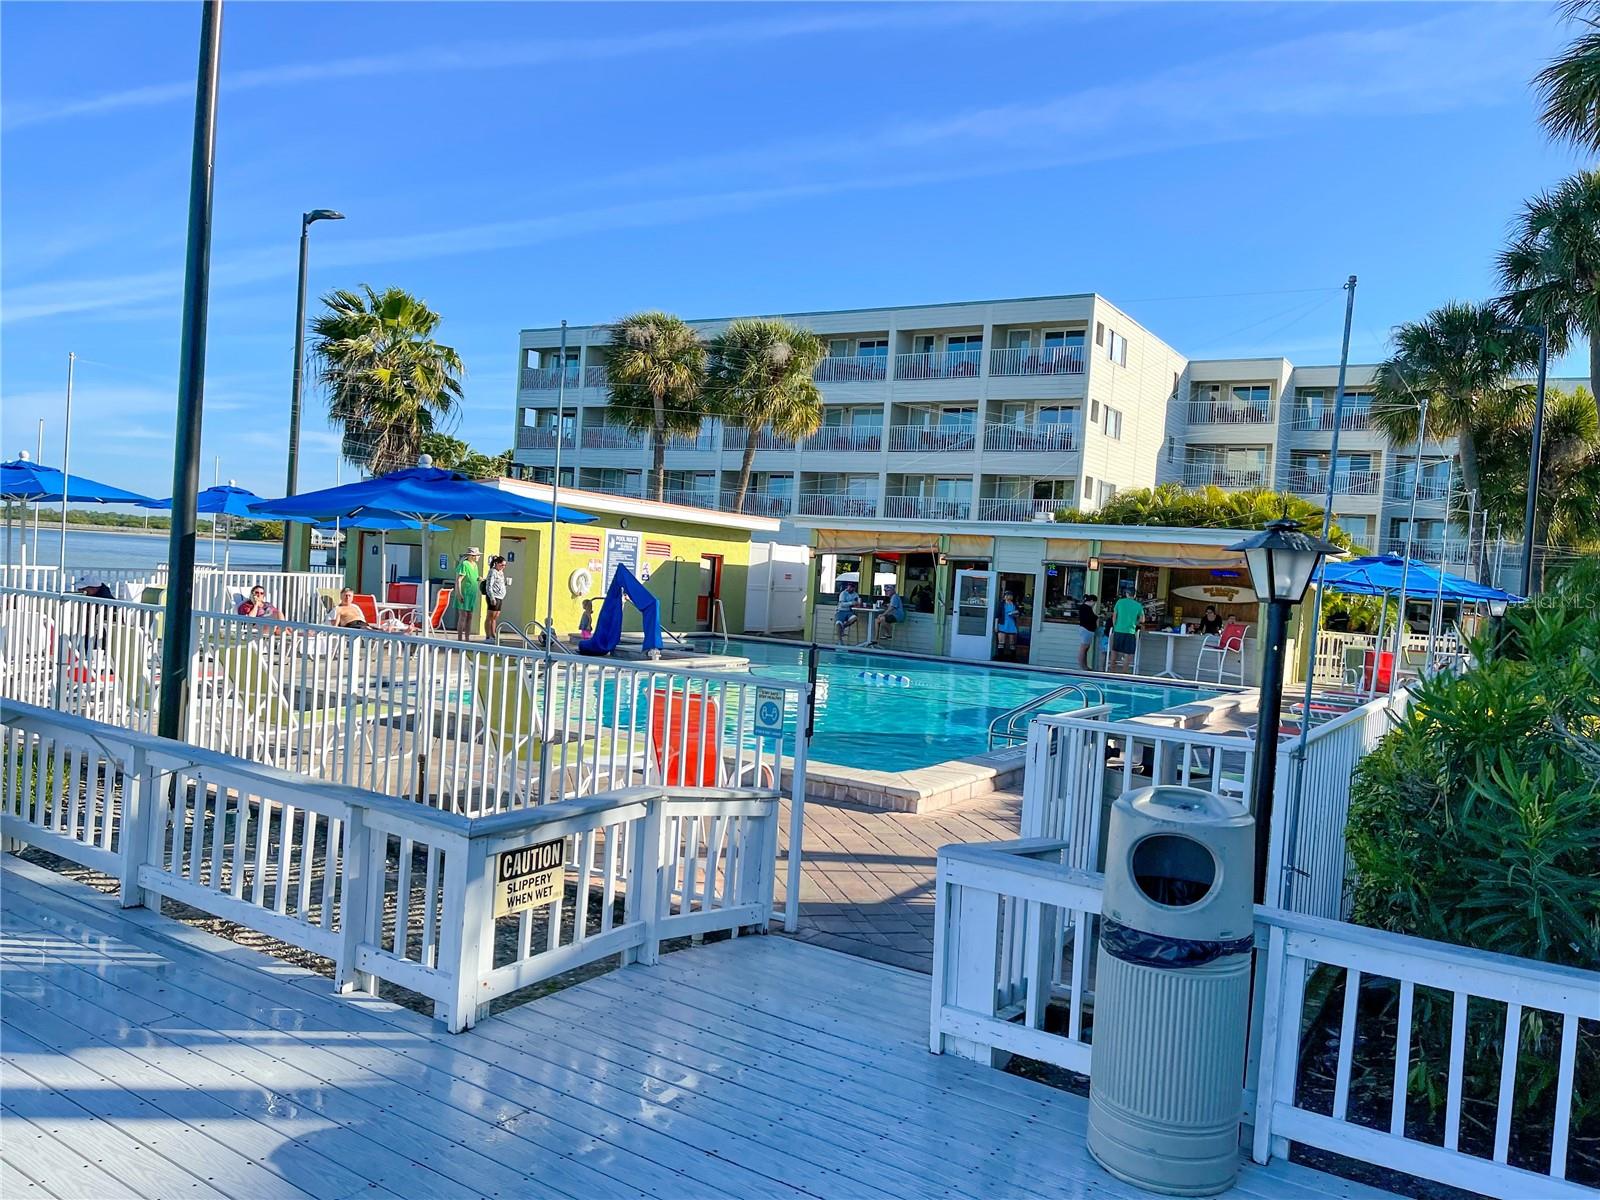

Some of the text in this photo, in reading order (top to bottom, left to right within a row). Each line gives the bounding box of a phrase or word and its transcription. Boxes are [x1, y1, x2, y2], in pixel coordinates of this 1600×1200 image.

[503, 842, 561, 878] CAUTION
[507, 872, 552, 895] SLIPPERY
[506, 885, 553, 908] WHEN WET
